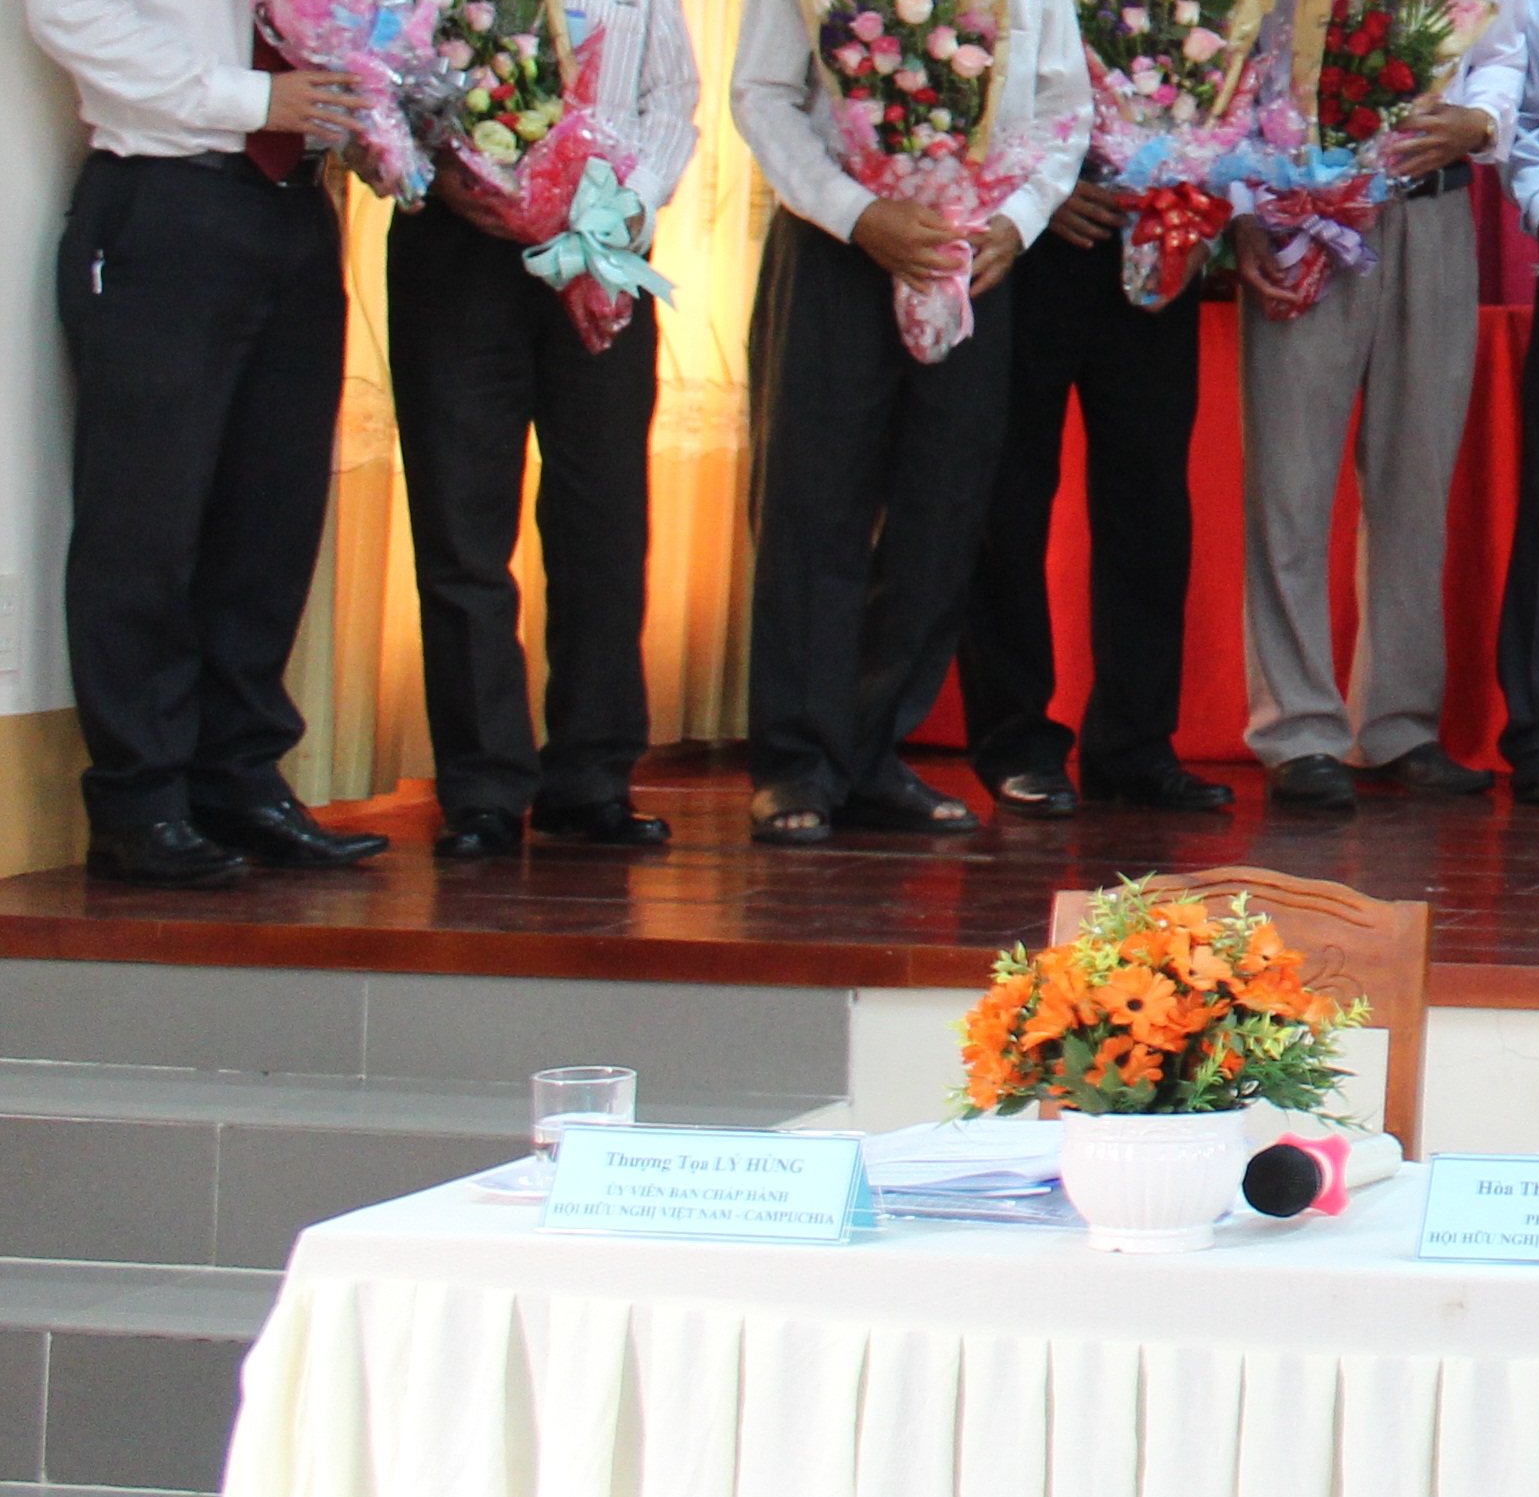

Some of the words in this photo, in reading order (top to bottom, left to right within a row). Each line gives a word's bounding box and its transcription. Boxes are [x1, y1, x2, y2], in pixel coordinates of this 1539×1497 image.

[669, 1186, 699, 1199] BAN
[1477, 1179, 1513, 1196] Hòa
[699, 1207, 733, 1220] NAM
[744, 1209, 835, 1225] CAMPUCHIA
